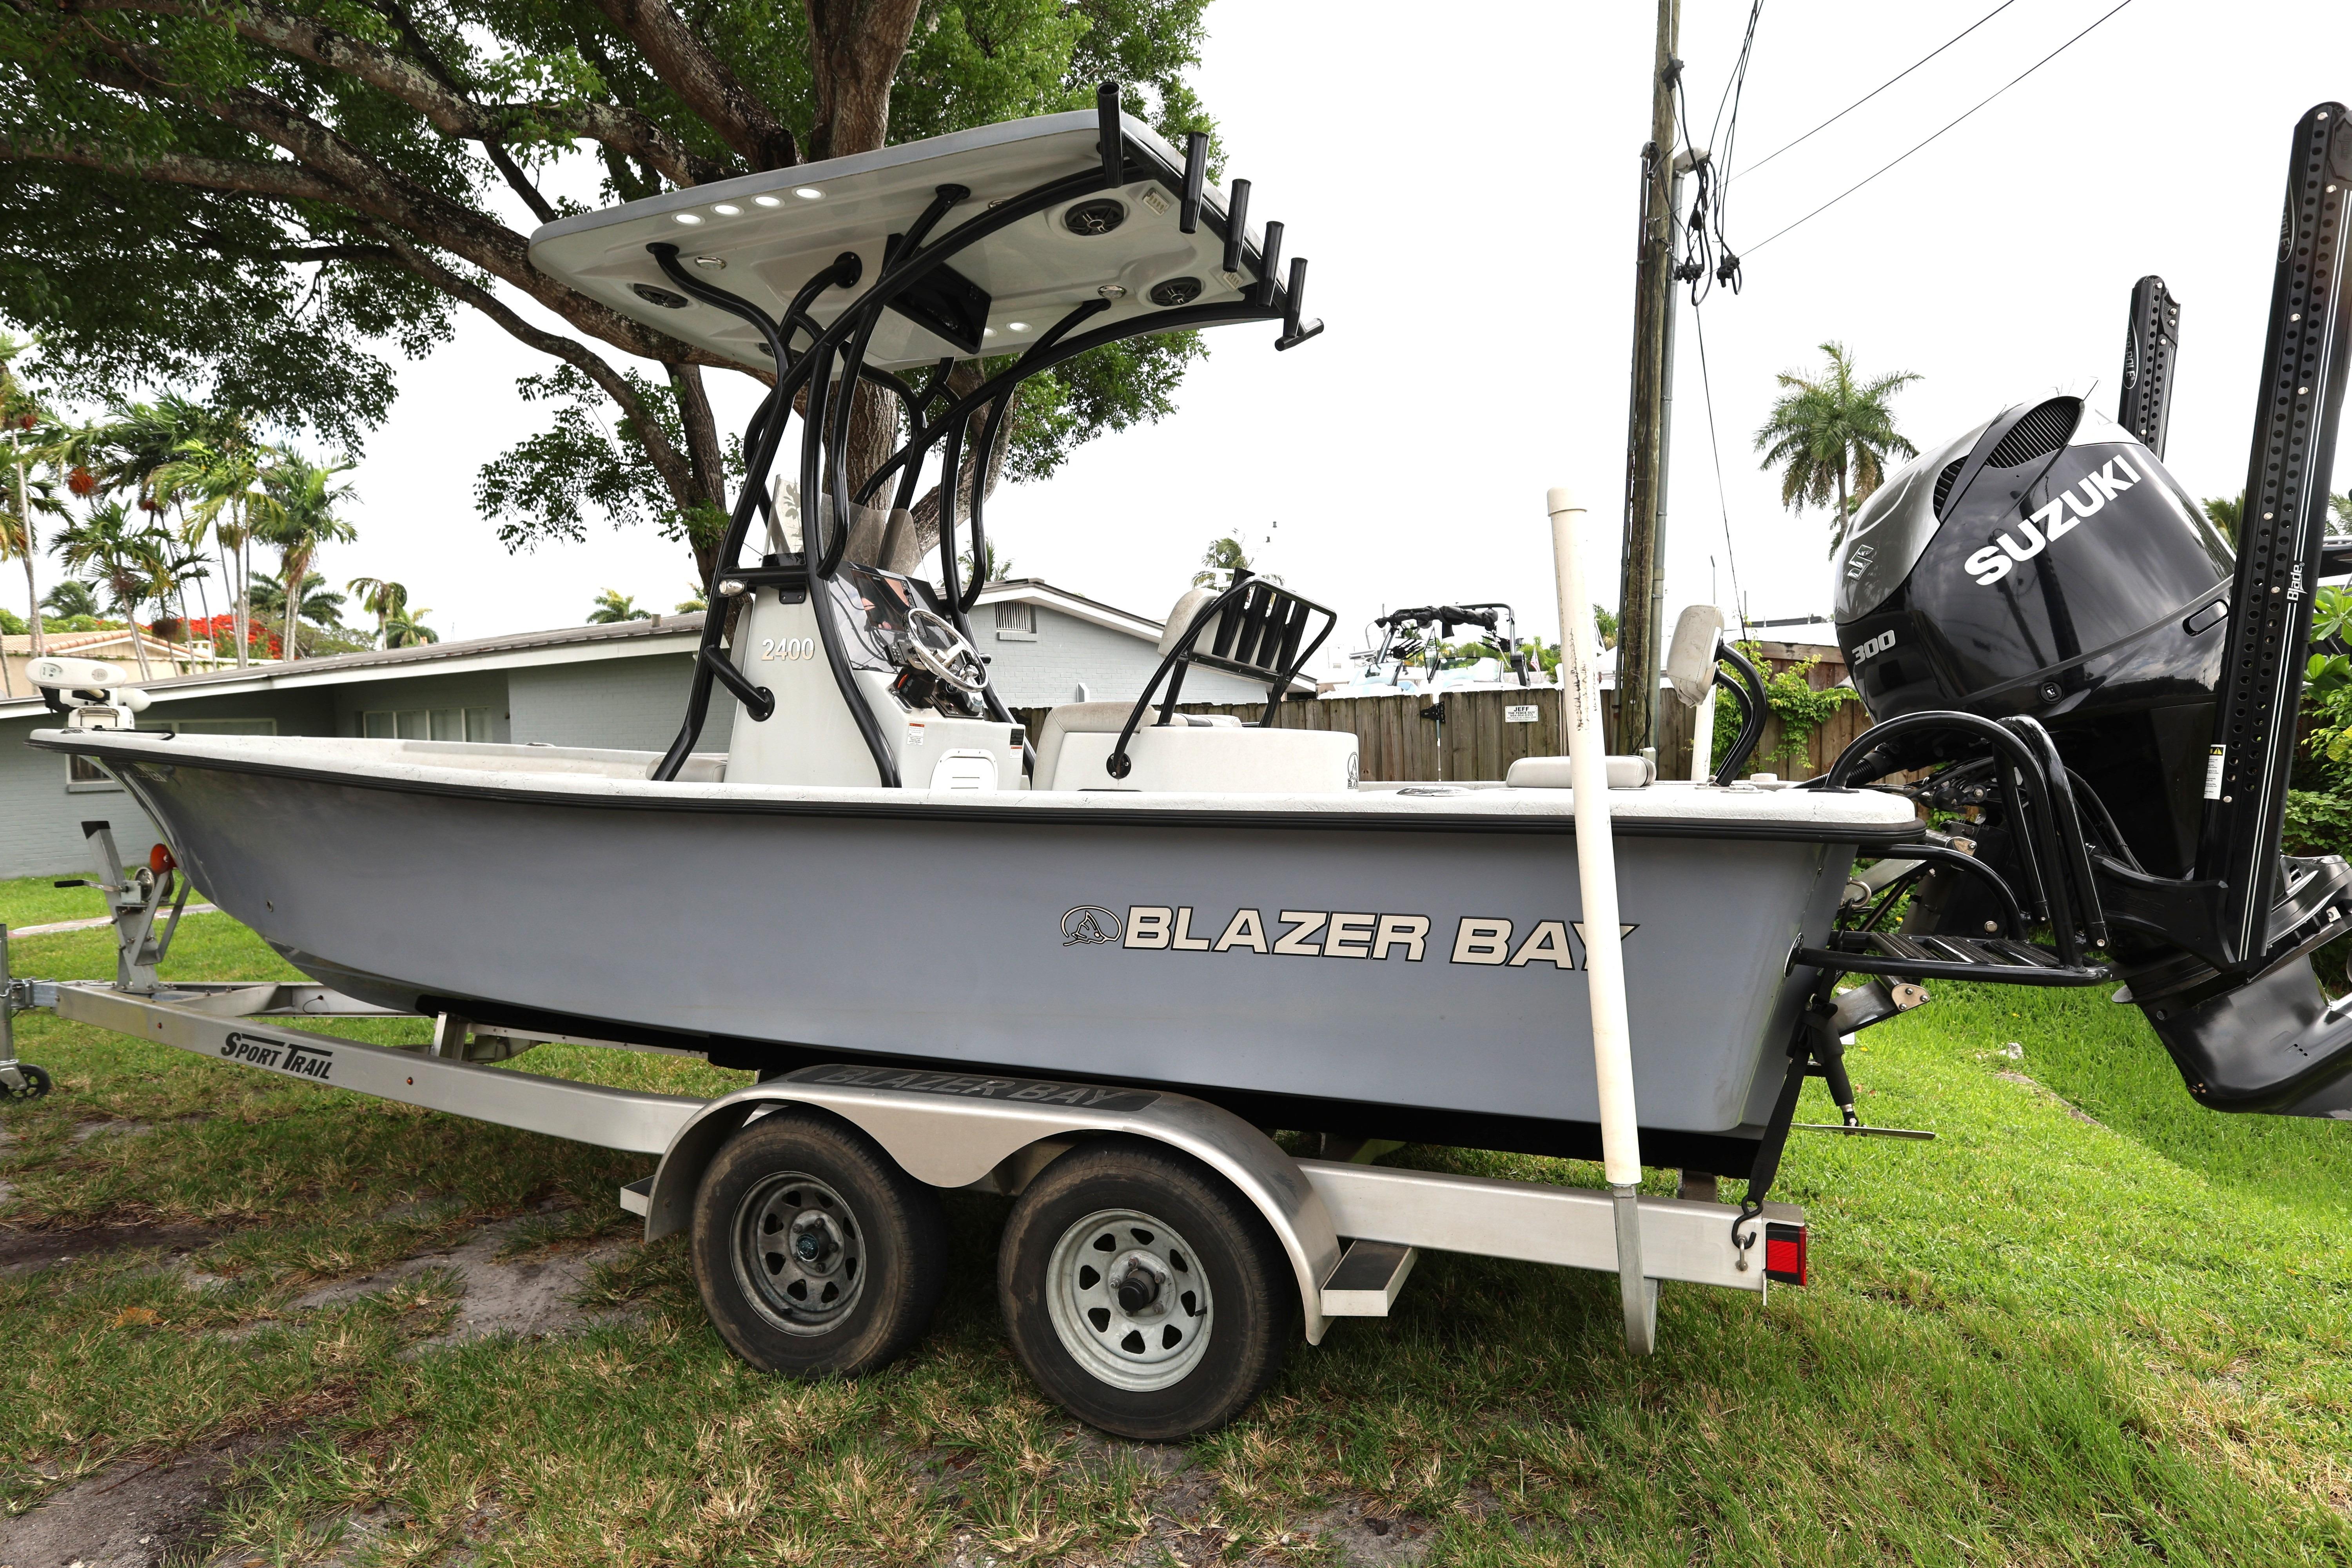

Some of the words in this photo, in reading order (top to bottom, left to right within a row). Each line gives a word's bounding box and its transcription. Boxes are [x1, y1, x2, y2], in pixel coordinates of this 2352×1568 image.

[1964, 454, 2141, 586] SUZUKI
[762, 638, 814, 661] 2400
[1852, 630, 1896, 665] 300
[1122, 905, 1431, 962] BLAZER
[221, 1032, 285, 1067] SPORT
[281, 1044, 333, 1080] TRAIL
[814, 1069, 1016, 1096] BLAZER
[1007, 1083, 1131, 1105] BAY
